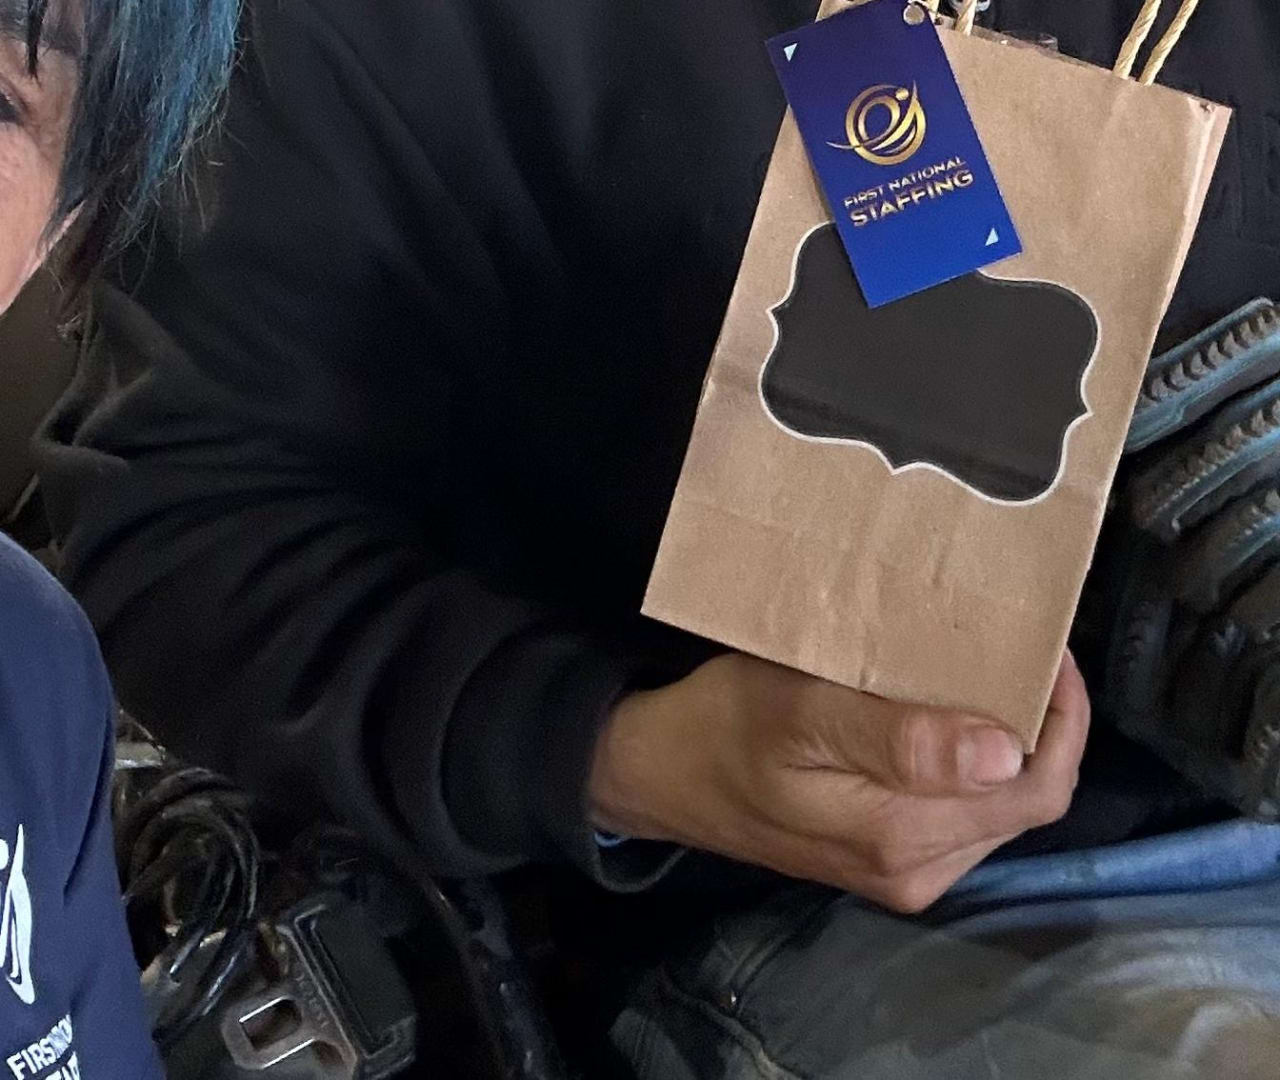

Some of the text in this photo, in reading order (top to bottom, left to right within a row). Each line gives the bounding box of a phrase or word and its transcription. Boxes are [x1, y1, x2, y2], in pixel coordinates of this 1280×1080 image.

[844, 156, 966, 207] FIRST NATIONAL
[850, 170, 974, 226] STAFFING
